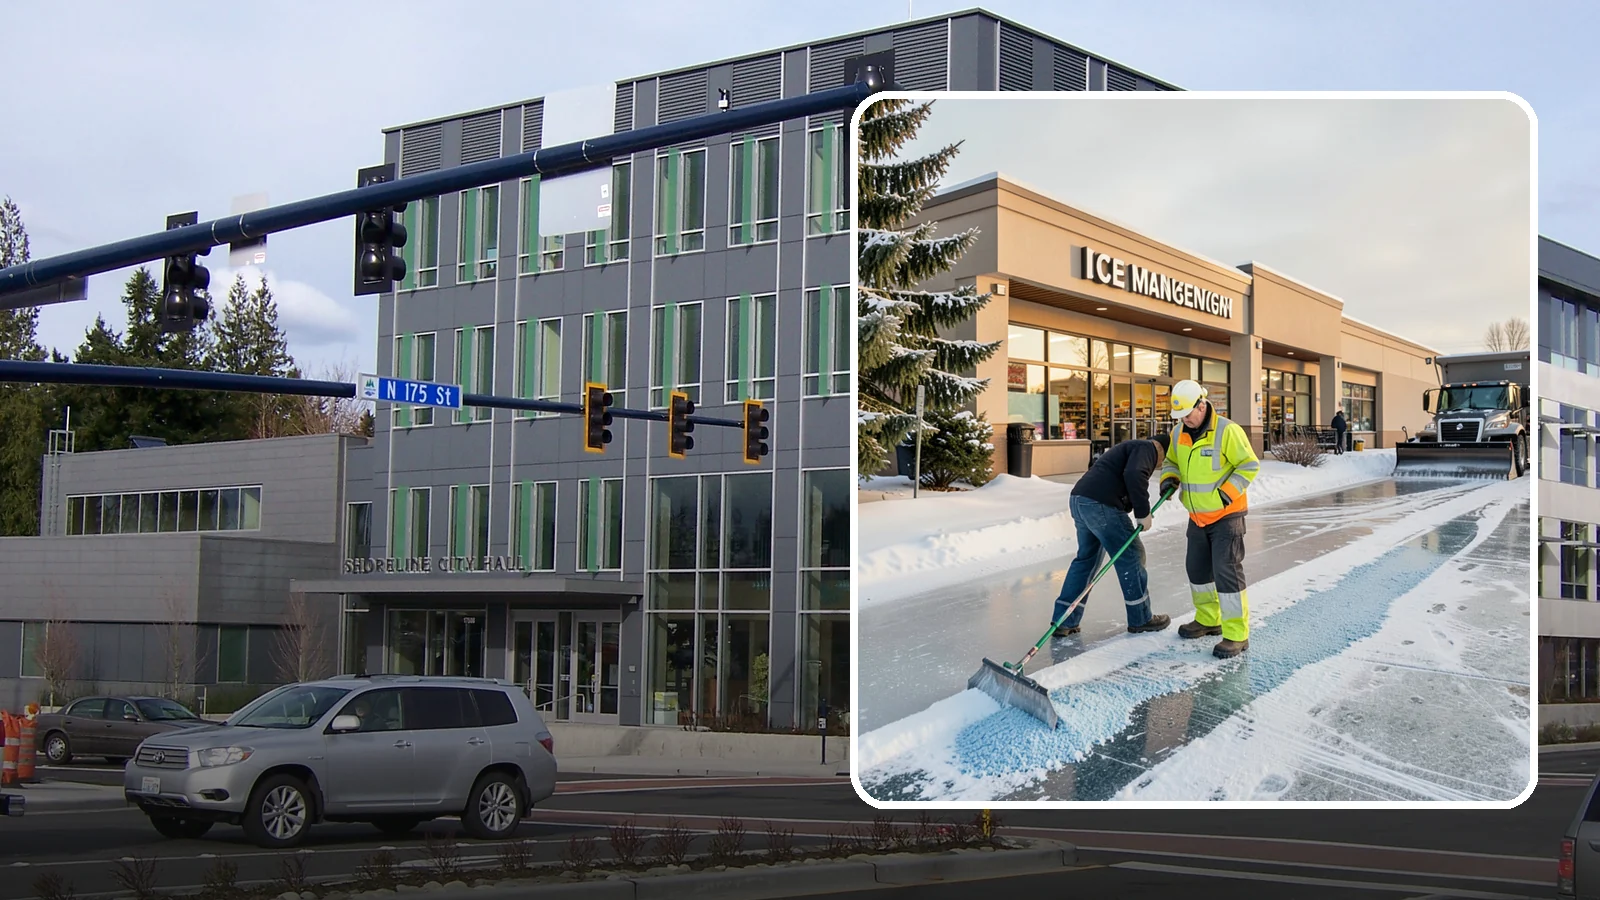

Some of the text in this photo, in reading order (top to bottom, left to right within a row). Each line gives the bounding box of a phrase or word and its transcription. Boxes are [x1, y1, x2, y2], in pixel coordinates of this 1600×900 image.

[1085, 246, 1125, 289] ICE
[387, 380, 451, 406] N 175 St
[345, 556, 525, 574] SHORELINE CITY HALL
